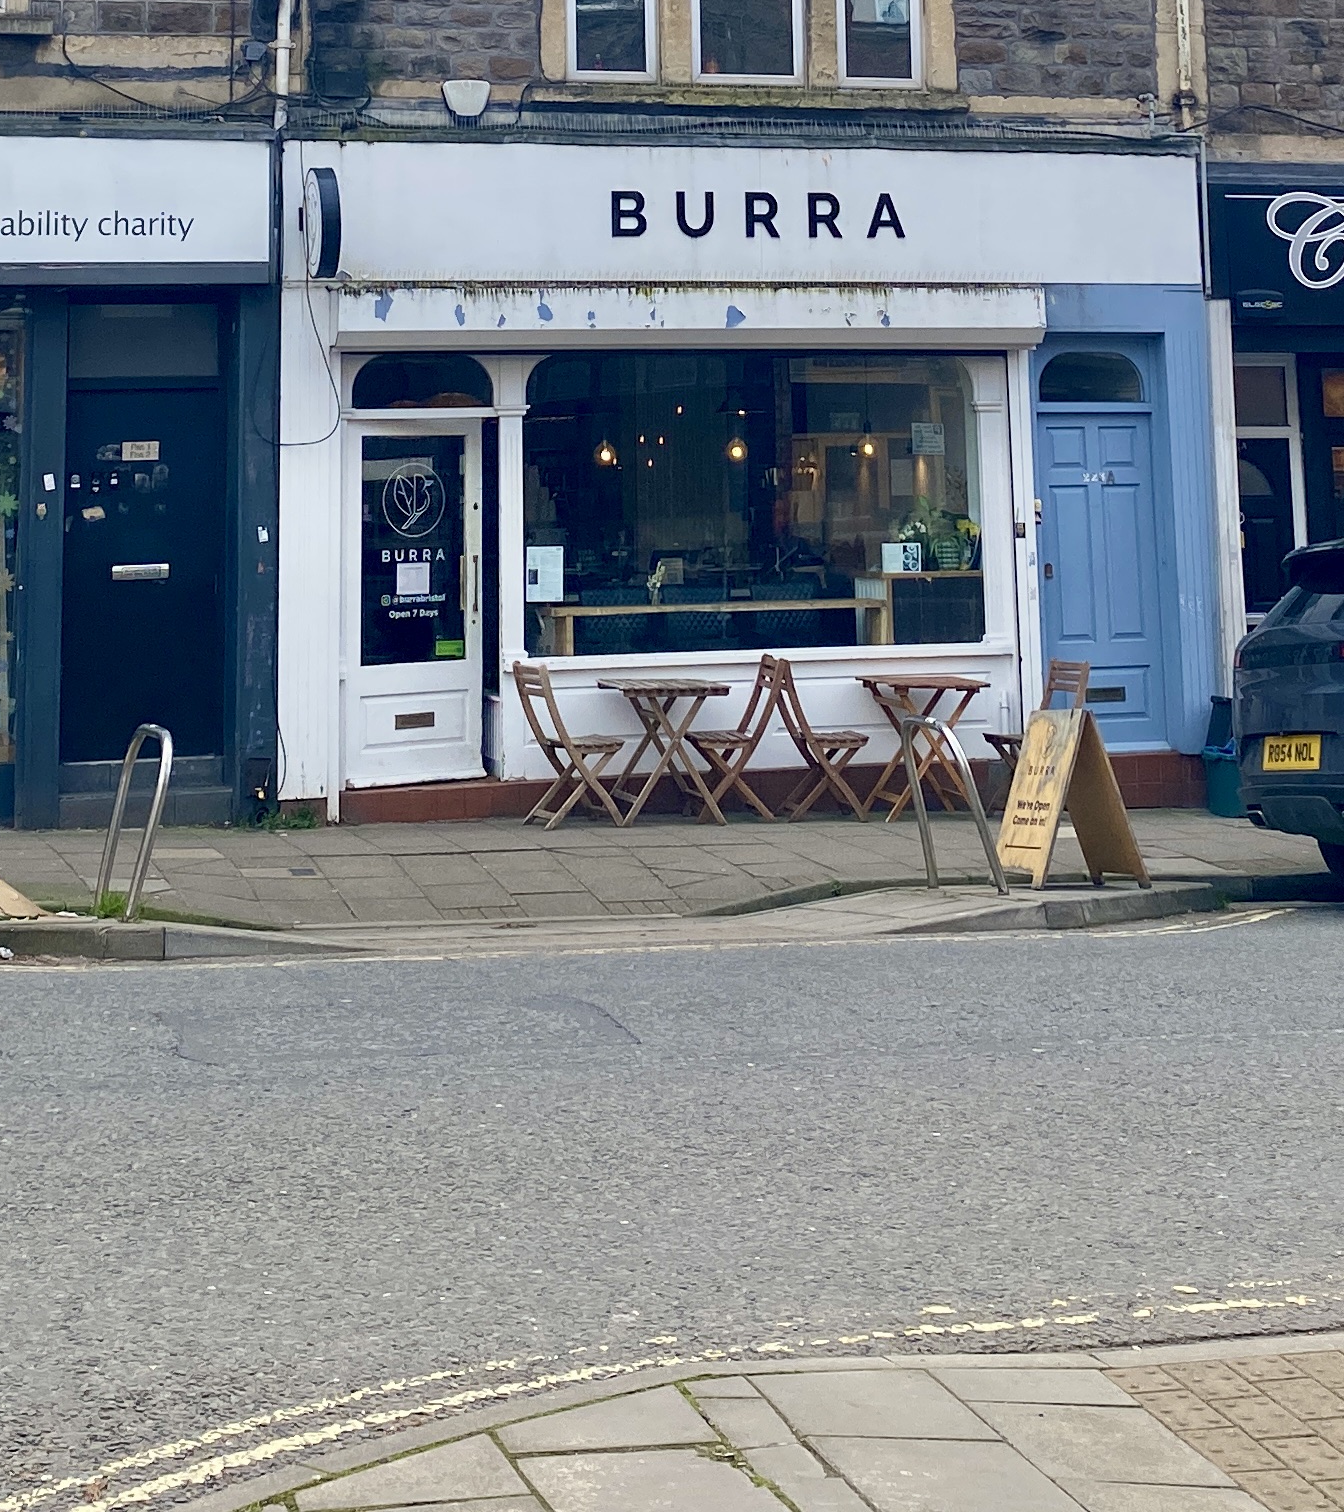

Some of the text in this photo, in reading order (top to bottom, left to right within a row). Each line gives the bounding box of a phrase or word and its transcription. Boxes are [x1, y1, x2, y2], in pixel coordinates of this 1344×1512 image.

[610, 190, 907, 240] BURRA
[97, 211, 196, 243] charity
[381, 548, 446, 563] BURRA
[388, 610, 411, 619] Open
[419, 609, 439, 618] Days
[1027, 765, 1055, 776] BURRA
[1033, 800, 1051, 813] Open
[1012, 814, 1030, 826] Come
